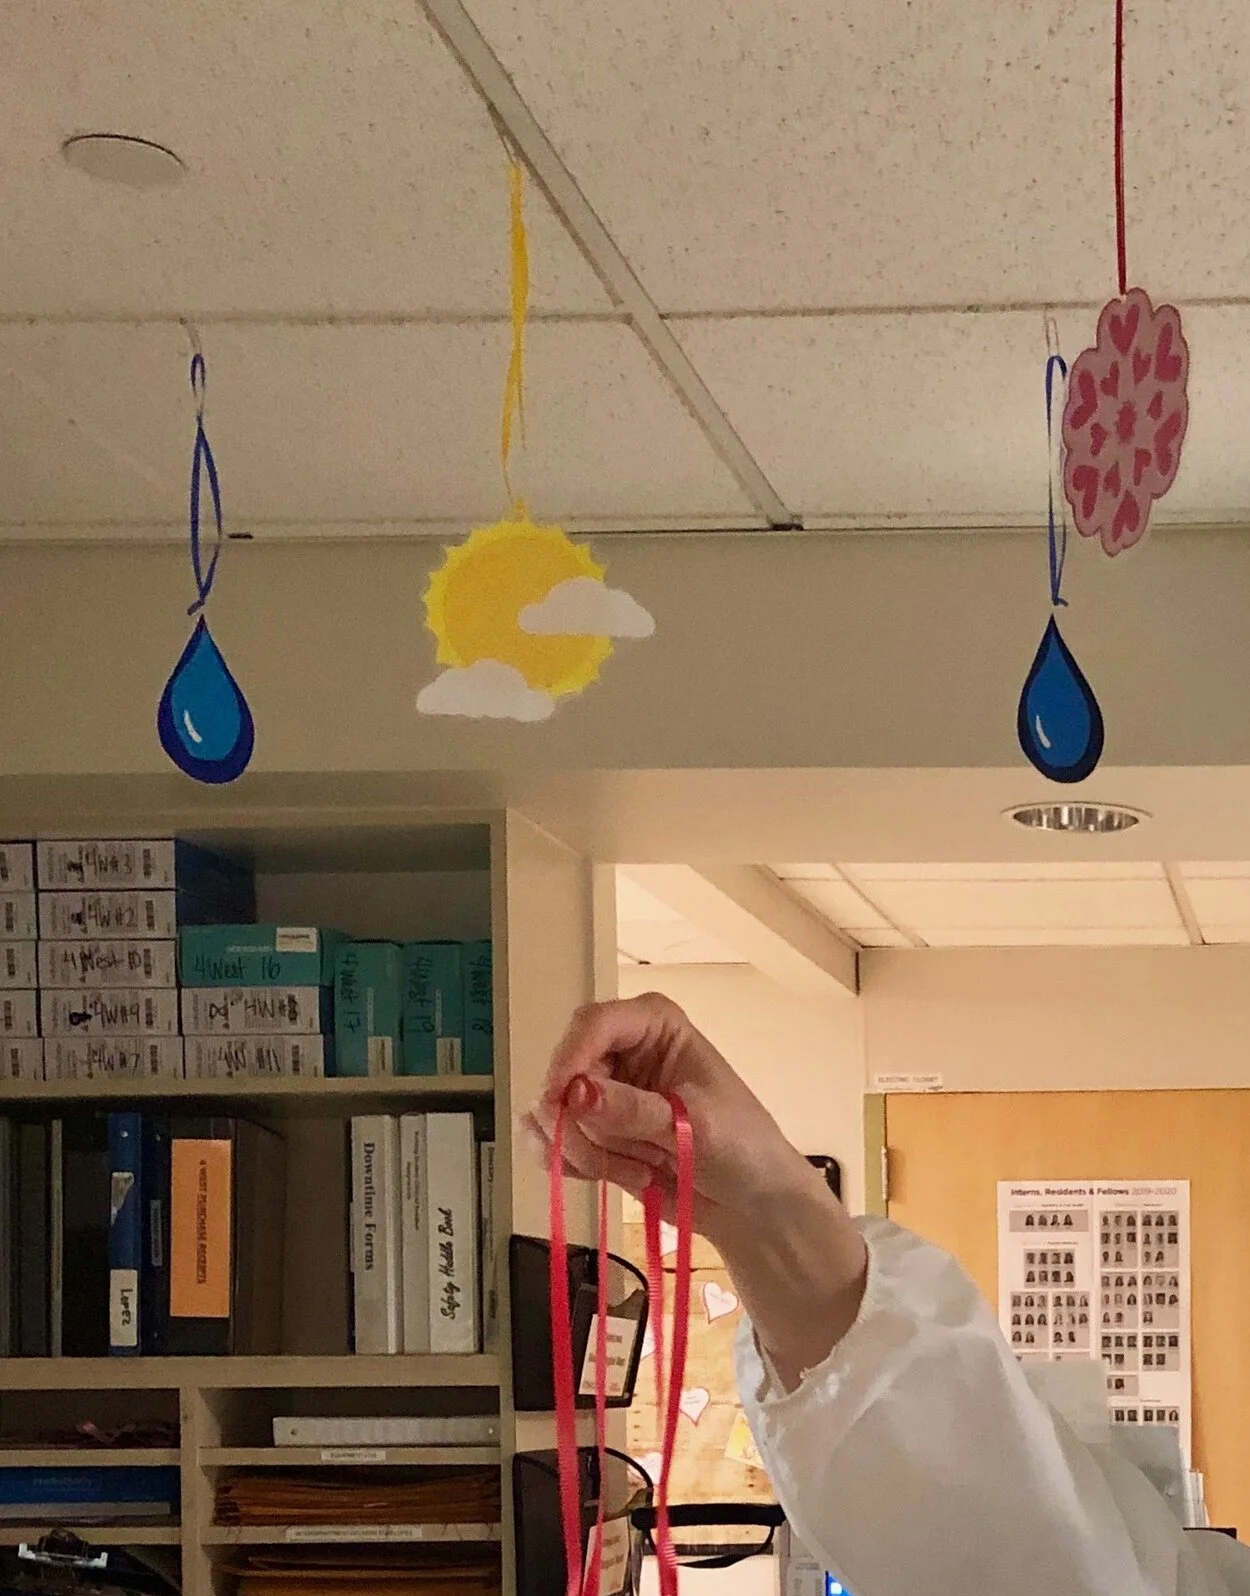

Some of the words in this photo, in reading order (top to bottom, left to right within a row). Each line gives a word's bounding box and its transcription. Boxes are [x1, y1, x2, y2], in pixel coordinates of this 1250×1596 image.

[262, 957, 281, 981] 16
[364, 1142, 376, 1217] Downtime
[1044, 1187, 1087, 1196] Residents
[1097, 1187, 1129, 1196] Fellows
[364, 1222, 377, 1271] Forms
